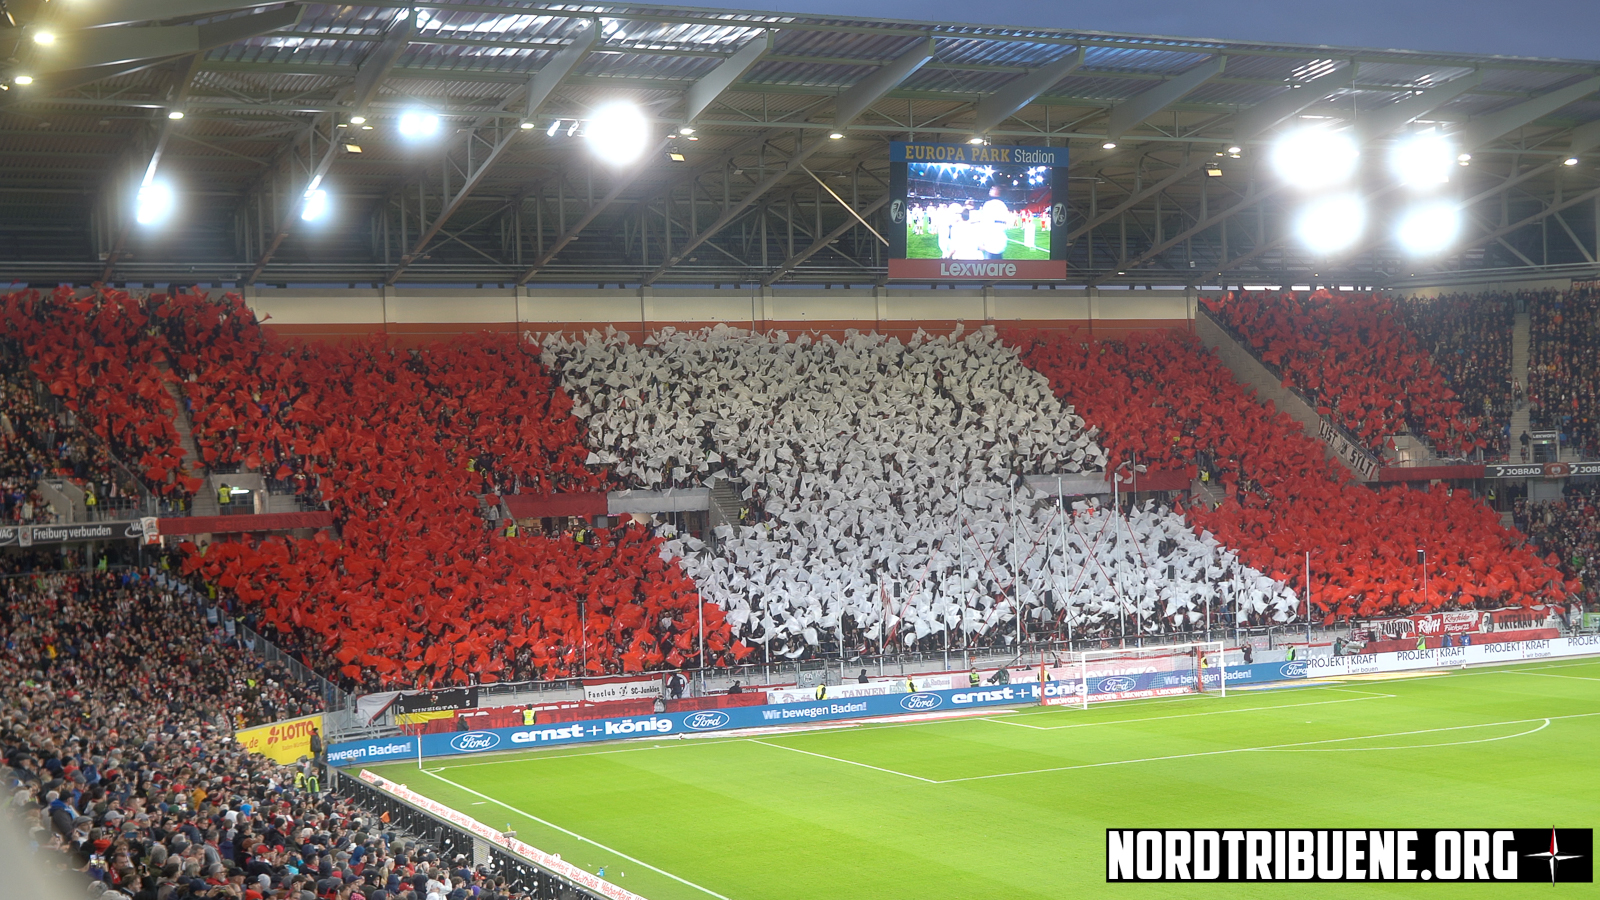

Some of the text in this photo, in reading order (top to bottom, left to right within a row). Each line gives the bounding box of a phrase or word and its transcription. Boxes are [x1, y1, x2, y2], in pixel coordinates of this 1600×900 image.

[905, 145, 1055, 163] EUROPA PARK Stadion
[940, 262, 1017, 277] Lexware
[1320, 422, 1373, 475] LIST SYLT
[1506, 468, 1541, 476] JOBRAD
[33, 525, 112, 541] Freiburg verbunden
[1380, 620, 1413, 635] ZORROS
[1498, 612, 1545, 630] ORTENAU 90
[1484, 639, 1550, 654] PROJEKT KRAFT
[1567, 636, 1600, 647] PROJEK
[1306, 653, 1378, 669] PROJEKT KRAFT
[1397, 646, 1466, 661] PROJEKT KRAFT
[1104, 678, 1129, 692] Ford
[1163, 675, 1179, 685] Wir
[588, 685, 661, 698] Fanclub SC-Junkies
[841, 687, 886, 698] TANNEN
[952, 682, 1088, 704] ernst + könig
[1121, 690, 1153, 699] Lexware
[908, 695, 935, 709] Ford
[762, 701, 867, 720] Wir bewegen Baden!
[692, 712, 721, 728] Ford
[281, 720, 315, 741] LOTTO
[511, 716, 673, 743] ernst + könig
[460, 734, 491, 749] Ford
[327, 742, 412, 761] ewegen Baden!
